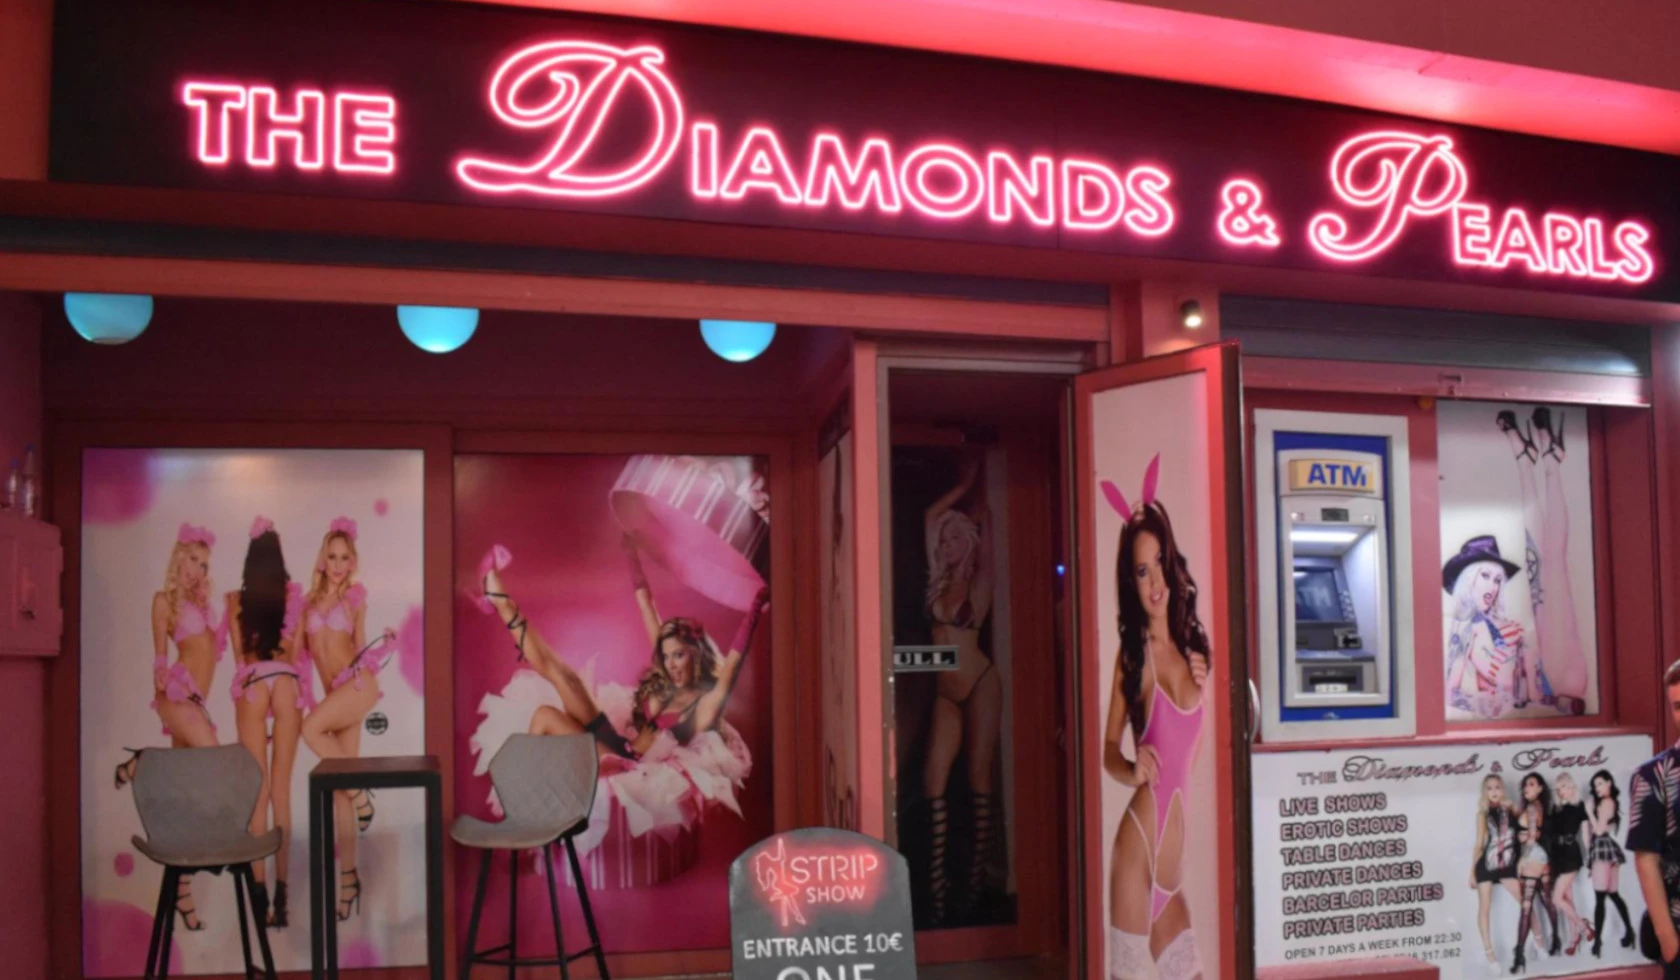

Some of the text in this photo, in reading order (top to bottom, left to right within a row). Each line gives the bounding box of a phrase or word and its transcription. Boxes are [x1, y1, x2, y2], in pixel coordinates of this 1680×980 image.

[183, 82, 397, 175] THE
[1217, 179, 1282, 248] &
[1306, 463, 1368, 488] ATM
[893, 651, 952, 667] ULL
[1297, 745, 1610, 786] THE Diamonds & Pearls
[1279, 791, 1388, 818] LIVE SHOWS
[1280, 814, 1409, 842] EROTIC SHOWS
[1281, 838, 1408, 866] TABLE DANCES
[790, 853, 879, 904] STRIP SHOW
[1282, 860, 1424, 890] PRIVATE DANCES
[1283, 883, 1445, 915] BARCELOR PARTIES
[1283, 908, 1425, 940] PRIVATE PARTIES
[743, 931, 904, 960] ENTRANCE 10€
[1285, 931, 1463, 960] OPEN 7 DAYS A WEEK FROM 22:30
